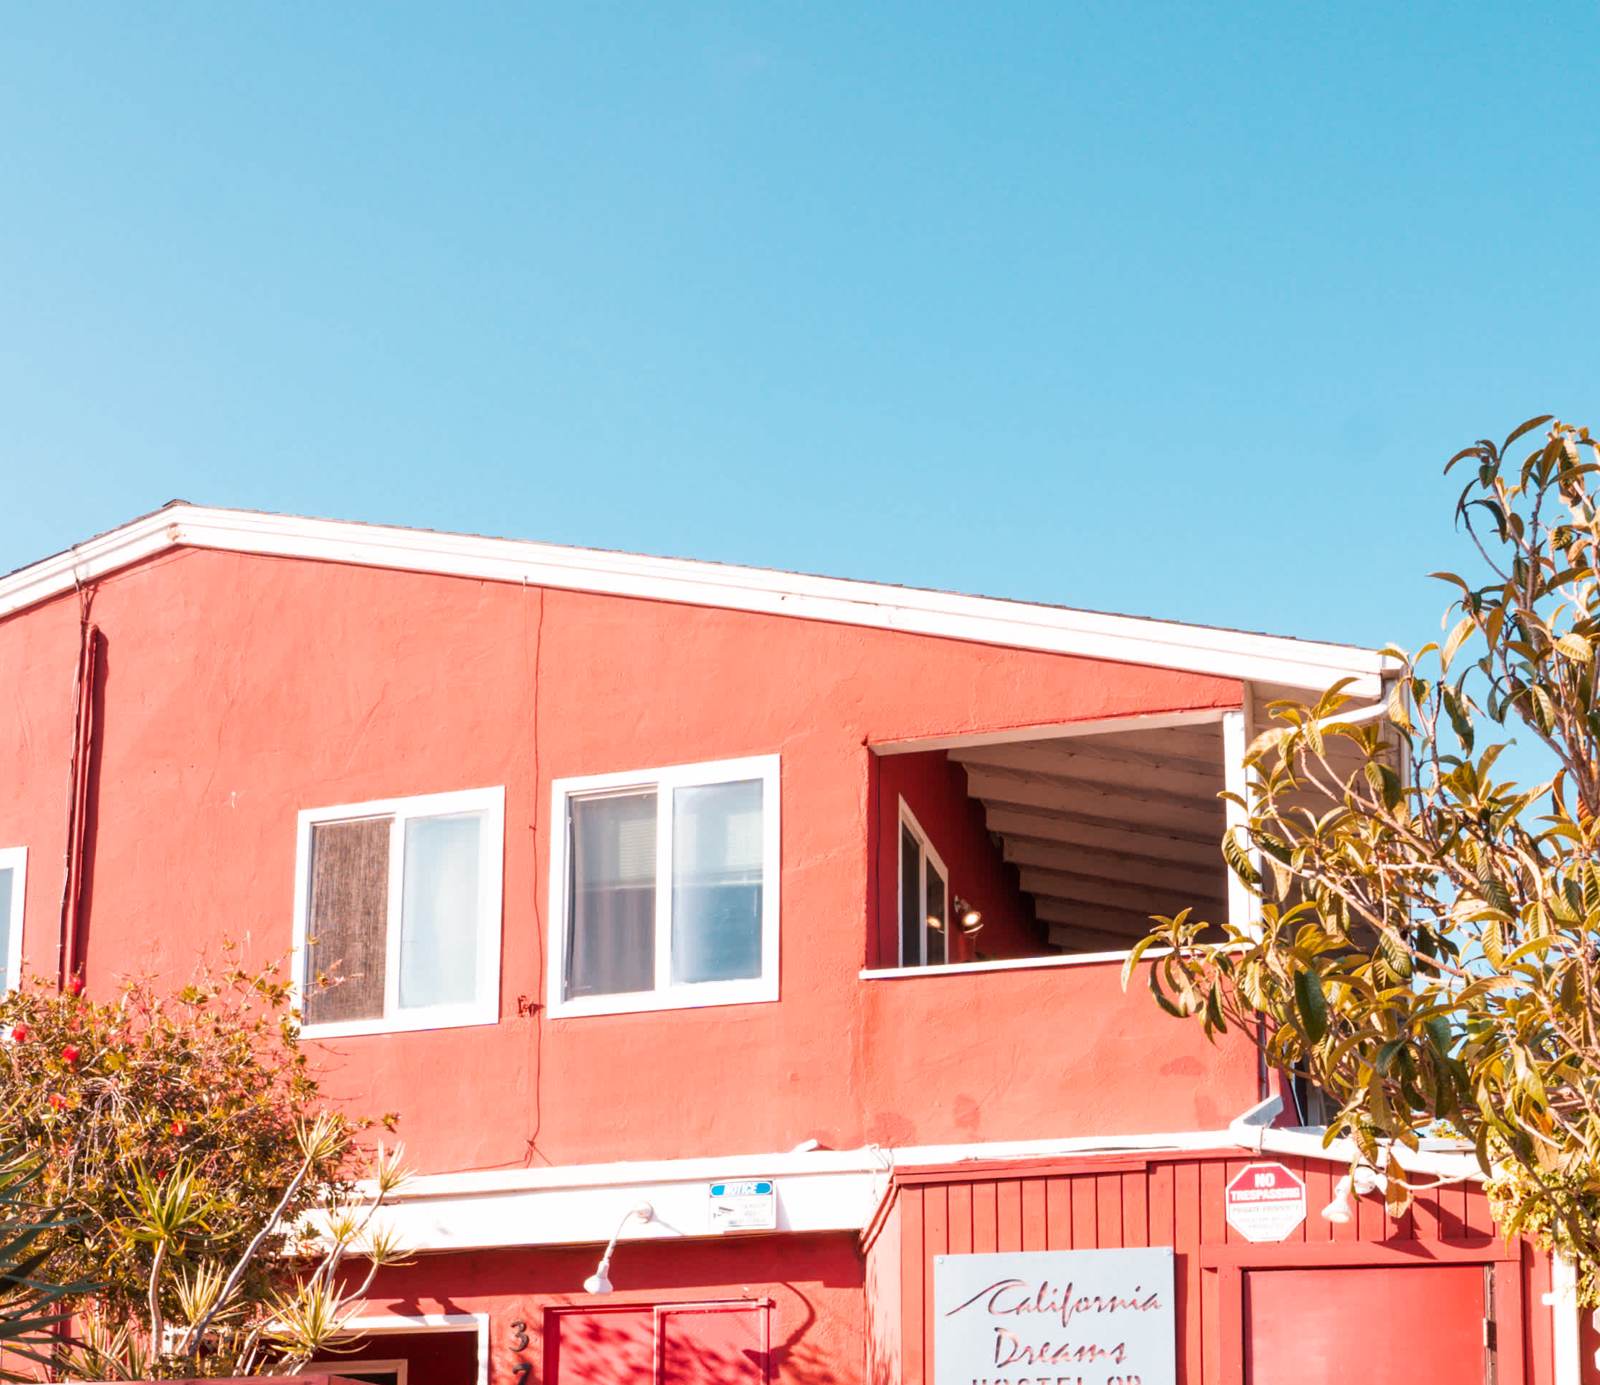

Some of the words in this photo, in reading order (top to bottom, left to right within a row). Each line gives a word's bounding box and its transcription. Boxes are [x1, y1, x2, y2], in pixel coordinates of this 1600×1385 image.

[1254, 1173, 1276, 1187] NO
[1230, 1188, 1300, 1201] TRESPASSING
[945, 1279, 1162, 1328] California
[994, 1326, 1127, 1369] Dreams
